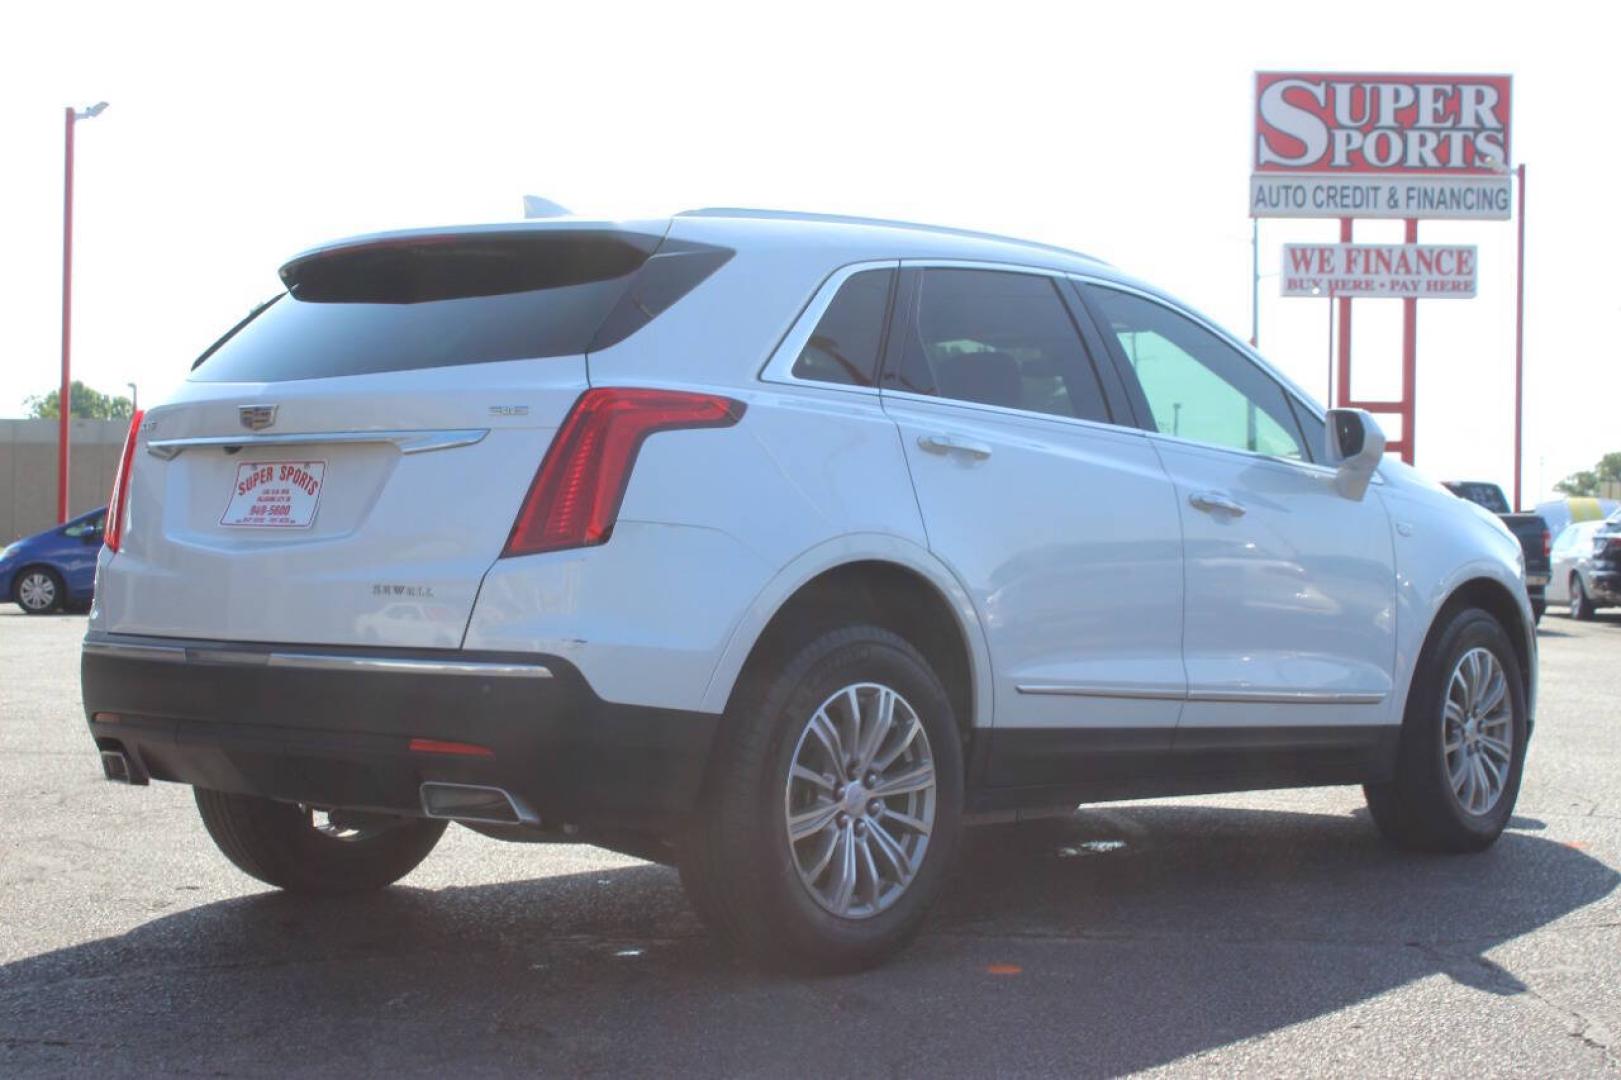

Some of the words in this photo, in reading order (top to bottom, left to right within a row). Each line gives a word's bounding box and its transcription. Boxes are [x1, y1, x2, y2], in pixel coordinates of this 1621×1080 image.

[1259, 79, 1503, 168] SUPER
[1255, 185, 1306, 209] AUTO
[1312, 185, 1382, 210] CREDIT
[1387, 186, 1399, 210] &
[1405, 186, 1508, 211] FINANCING
[1288, 247, 1335, 275] WE
[1344, 247, 1473, 276] FINANCE
[1287, 279, 1323, 292] BUY
[1329, 279, 1375, 292] HERE
[1390, 280, 1421, 292] PAY
[1426, 280, 1473, 293] HERE
[238, 465, 273, 495] SUPER
[280, 465, 318, 495] SPORTS
